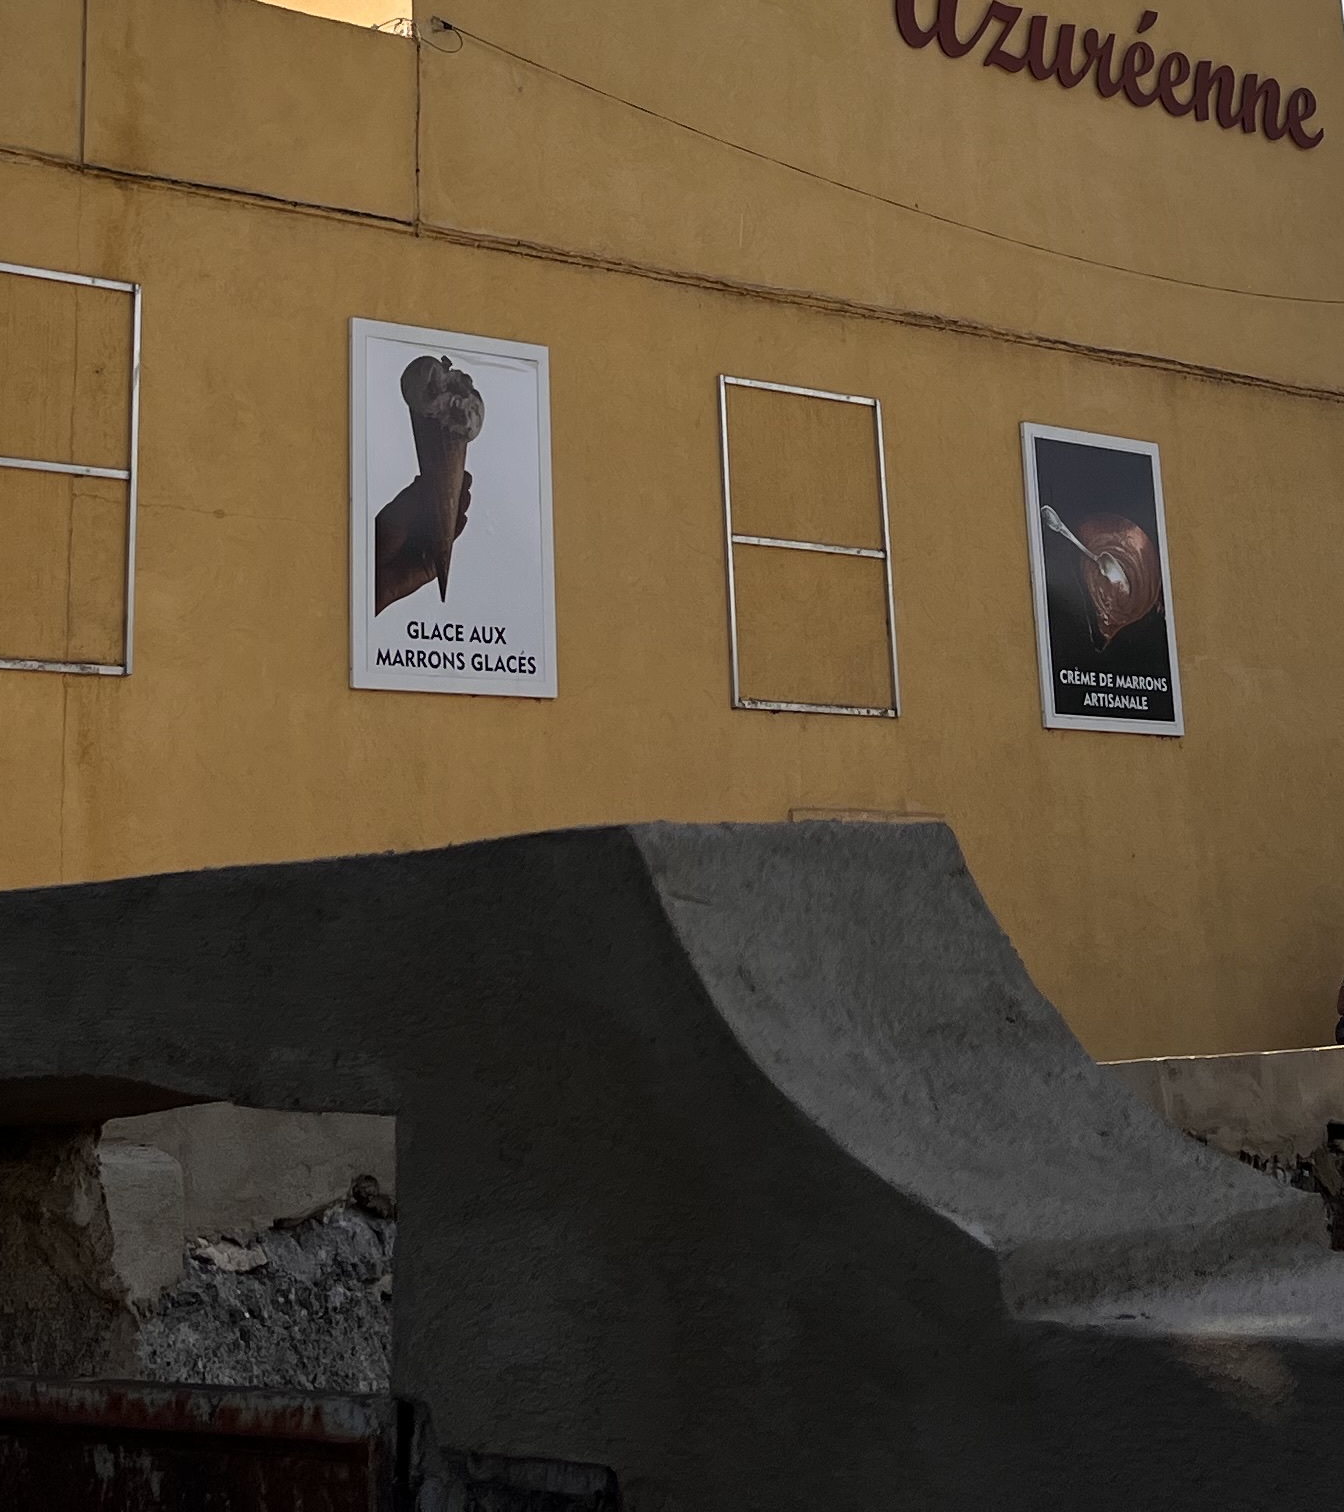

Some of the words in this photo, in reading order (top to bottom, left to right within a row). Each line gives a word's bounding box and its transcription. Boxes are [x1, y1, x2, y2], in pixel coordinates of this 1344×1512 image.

[407, 621, 464, 642] GLACE
[469, 626, 506, 644] AUX
[376, 648, 465, 671] MARRONS
[471, 650, 537, 674] GLACÉS
[1059, 667, 1096, 686] CRÈME
[1099, 672, 1113, 687] DE
[1116, 675, 1168, 692] MARRONS
[1083, 692, 1149, 710] ARTISANALE
